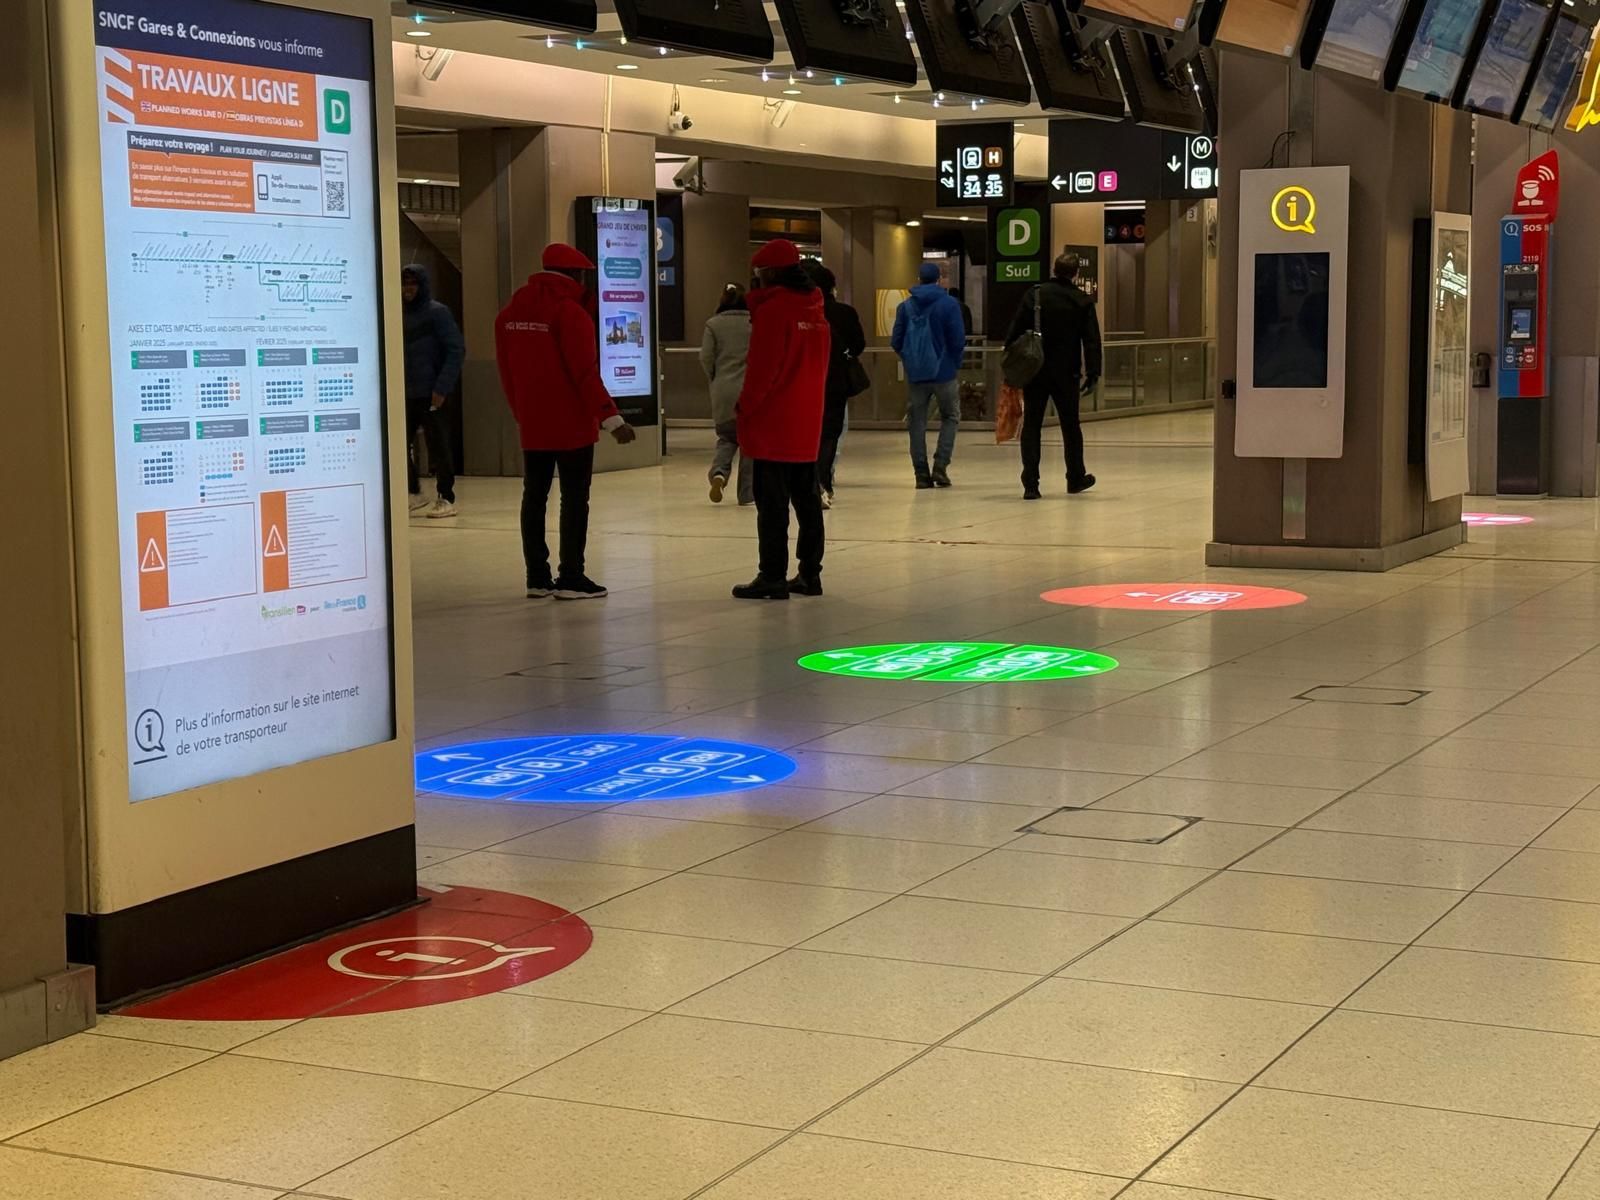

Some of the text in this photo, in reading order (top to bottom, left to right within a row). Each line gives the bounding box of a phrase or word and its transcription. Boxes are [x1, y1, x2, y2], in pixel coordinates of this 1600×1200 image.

[98, 11, 323, 58] SNCF Gares & Connexions vous informe
[137, 63, 345, 124] TRAVAUX LIGNE D
[151, 103, 180, 115] PLANNED
[180, 106, 202, 117] WORKS
[203, 108, 216, 118] LINE
[130, 134, 163, 148] Préparez
[164, 139, 183, 149] votre
[184, 142, 209, 154] voyage
[1196, 140, 1207, 154] M
[988, 151, 999, 164] H
[963, 180, 1003, 195] 34 35
[1078, 175, 1112, 188] RER E
[1008, 219, 1031, 246] D
[1523, 224, 1542, 232] SOS
[1005, 264, 1031, 277] Sud
[175, 685, 360, 733] Plus d'information sur le site internet
[176, 721, 288, 755] de votre transporteur
